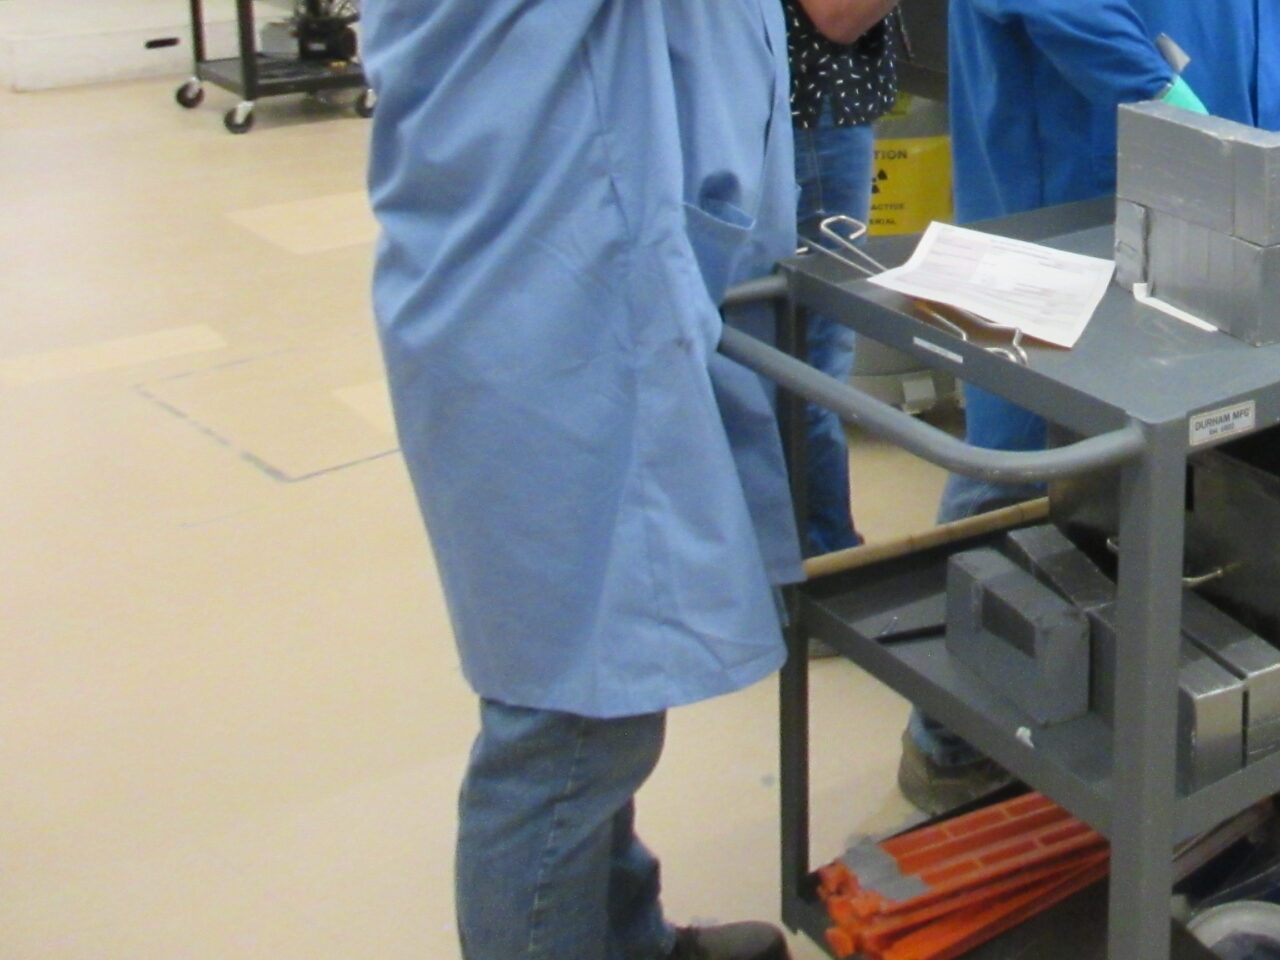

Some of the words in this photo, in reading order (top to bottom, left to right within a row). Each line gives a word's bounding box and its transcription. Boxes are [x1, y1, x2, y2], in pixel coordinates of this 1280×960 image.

[873, 149, 908, 160] TION
[871, 202, 905, 210] ACTIVE
[1194, 413, 1231, 431] DURHAM
